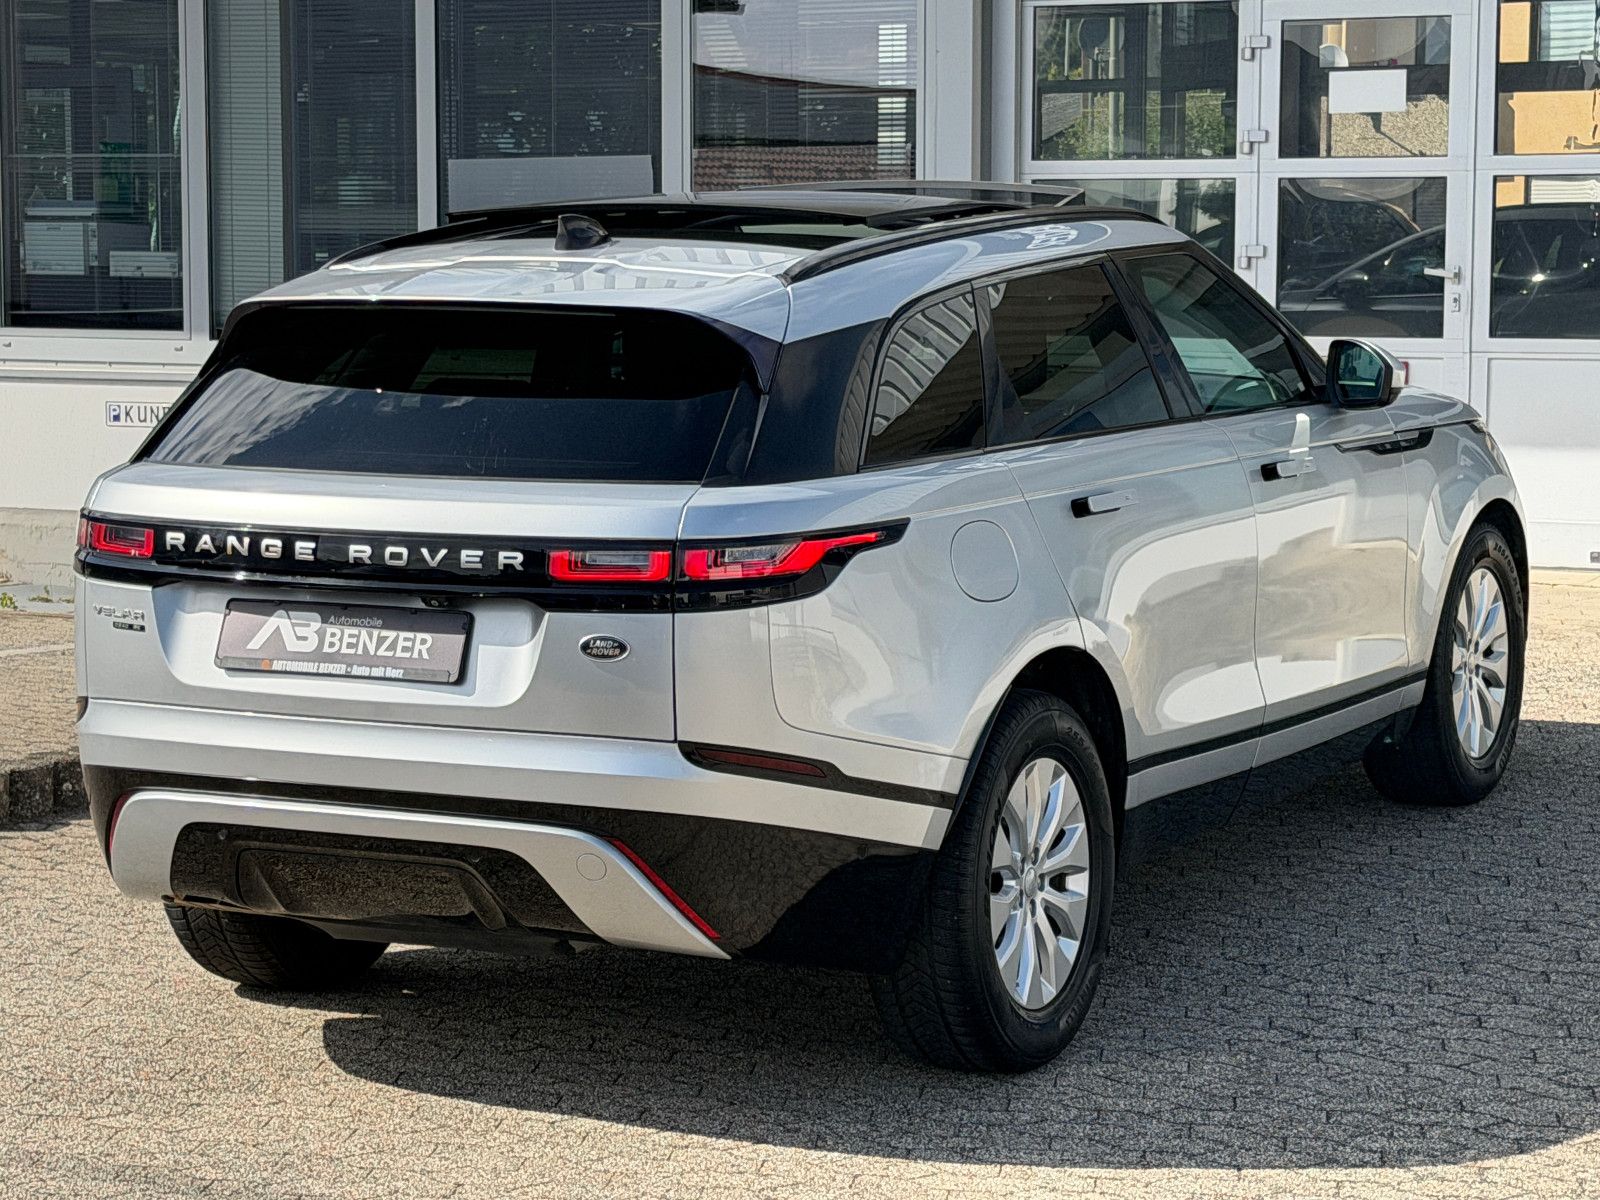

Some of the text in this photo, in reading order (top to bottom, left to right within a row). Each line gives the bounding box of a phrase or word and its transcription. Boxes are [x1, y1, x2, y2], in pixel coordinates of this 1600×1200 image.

[164, 531, 525, 571] RANGE ROVER
[328, 615, 383, 628] Automobile
[323, 627, 433, 660] BENZER
[590, 639, 613, 648] LAND
[591, 648, 620, 656] ROVER
[272, 659, 319, 673] AUTOMOBILE
[318, 662, 347, 675] BENZER
[351, 664, 371, 677] Auto
[371, 667, 385, 677] mit
